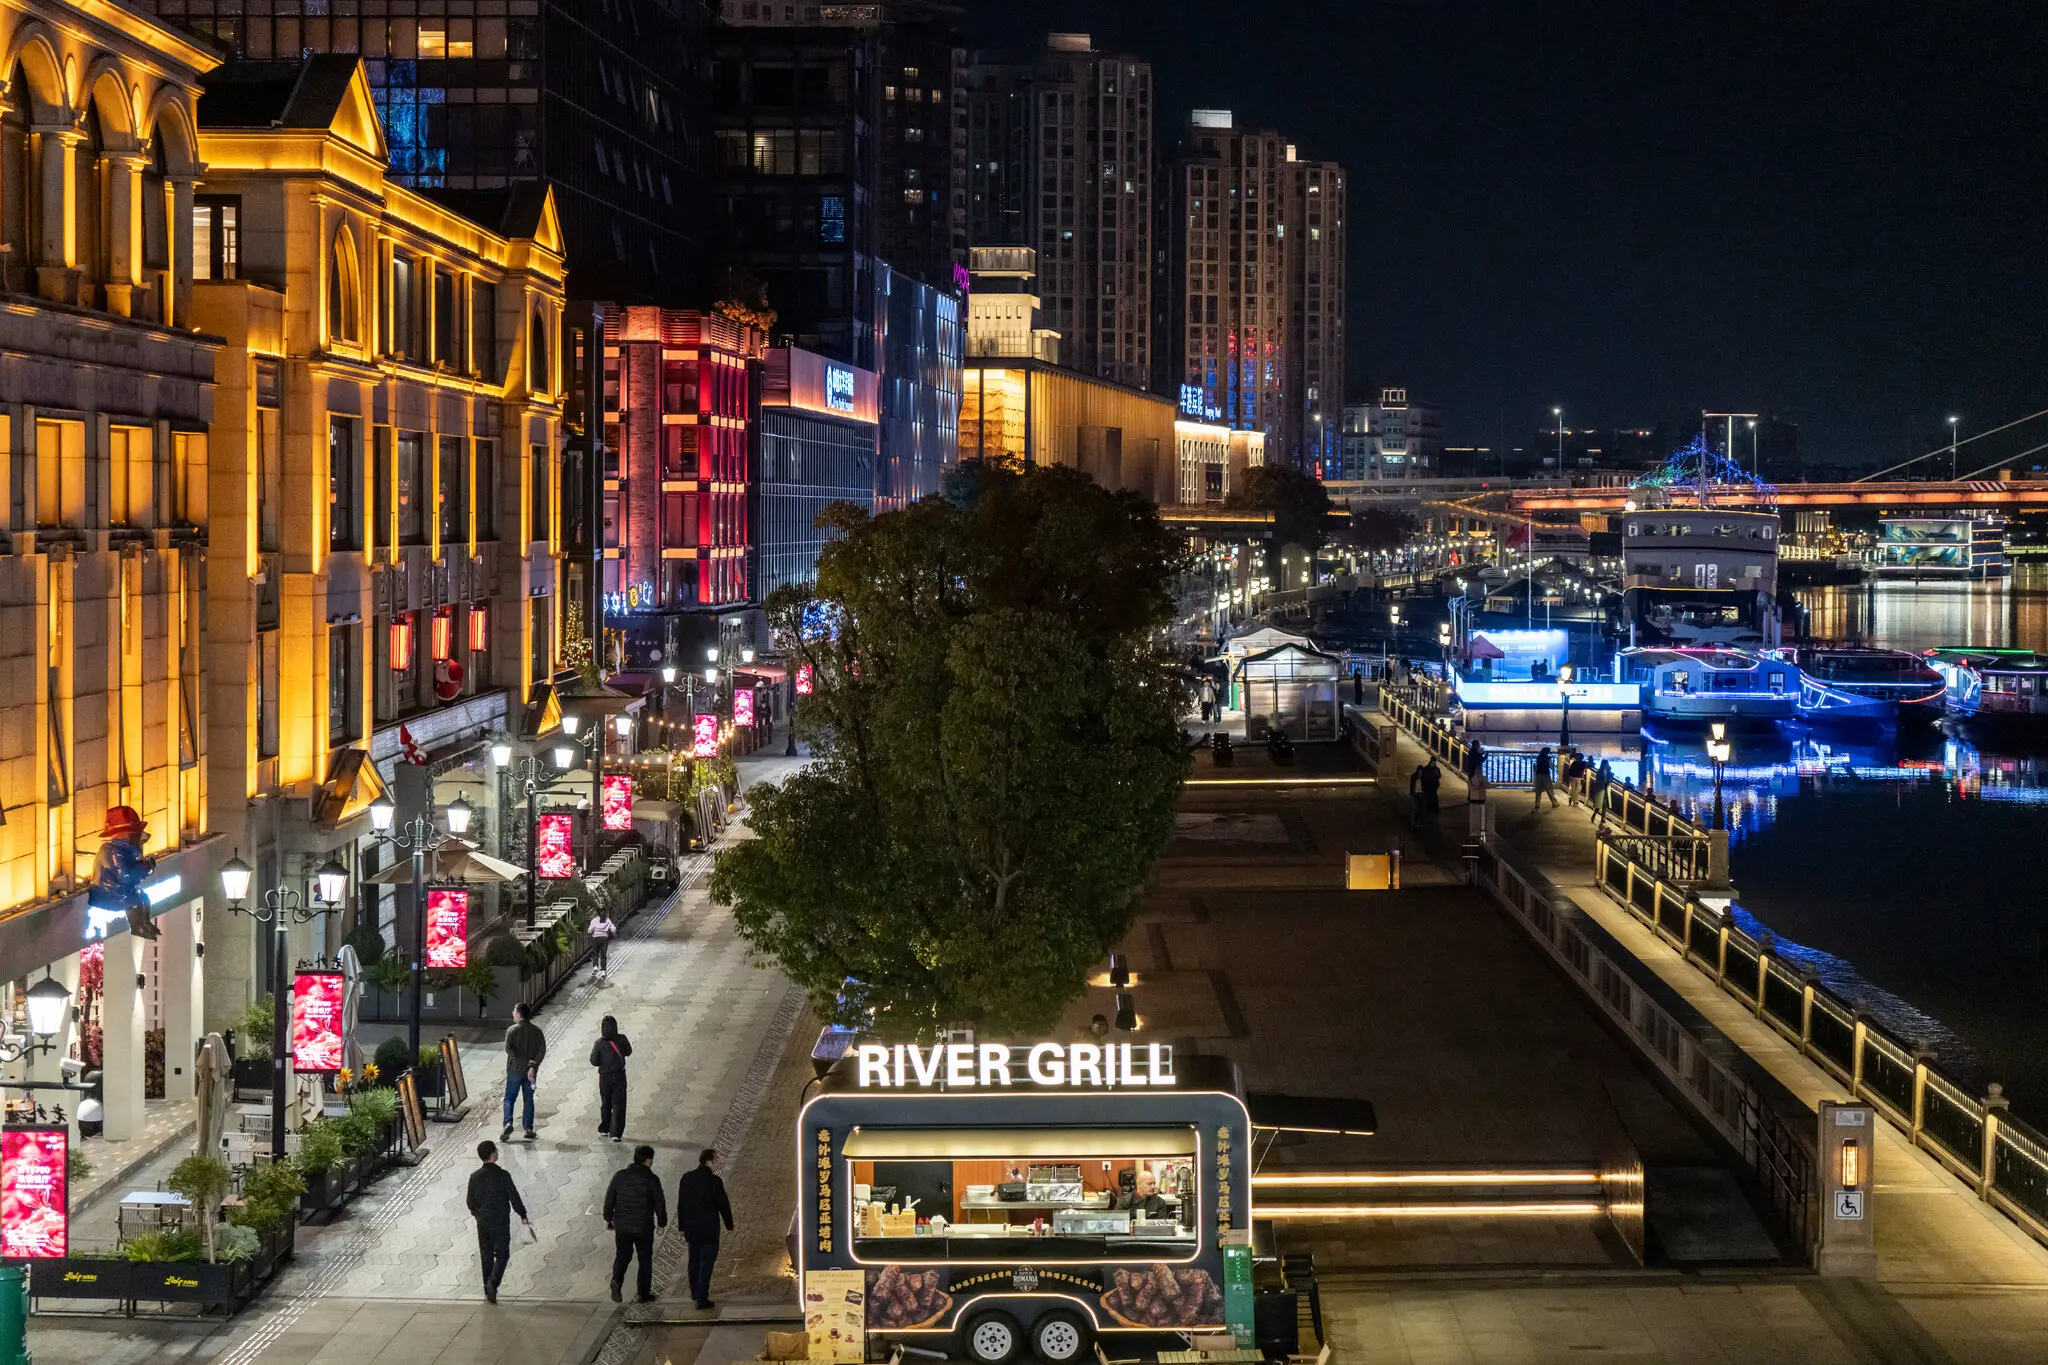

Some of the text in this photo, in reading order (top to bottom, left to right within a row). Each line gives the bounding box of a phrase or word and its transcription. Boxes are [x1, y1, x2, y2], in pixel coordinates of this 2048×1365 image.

[858, 1042, 1177, 1086] RIVER GRILL
[817, 1129, 832, 1253] 老外滩罗马尼亚烤肉
[1013, 1275, 1039, 1283] ROMANIA
